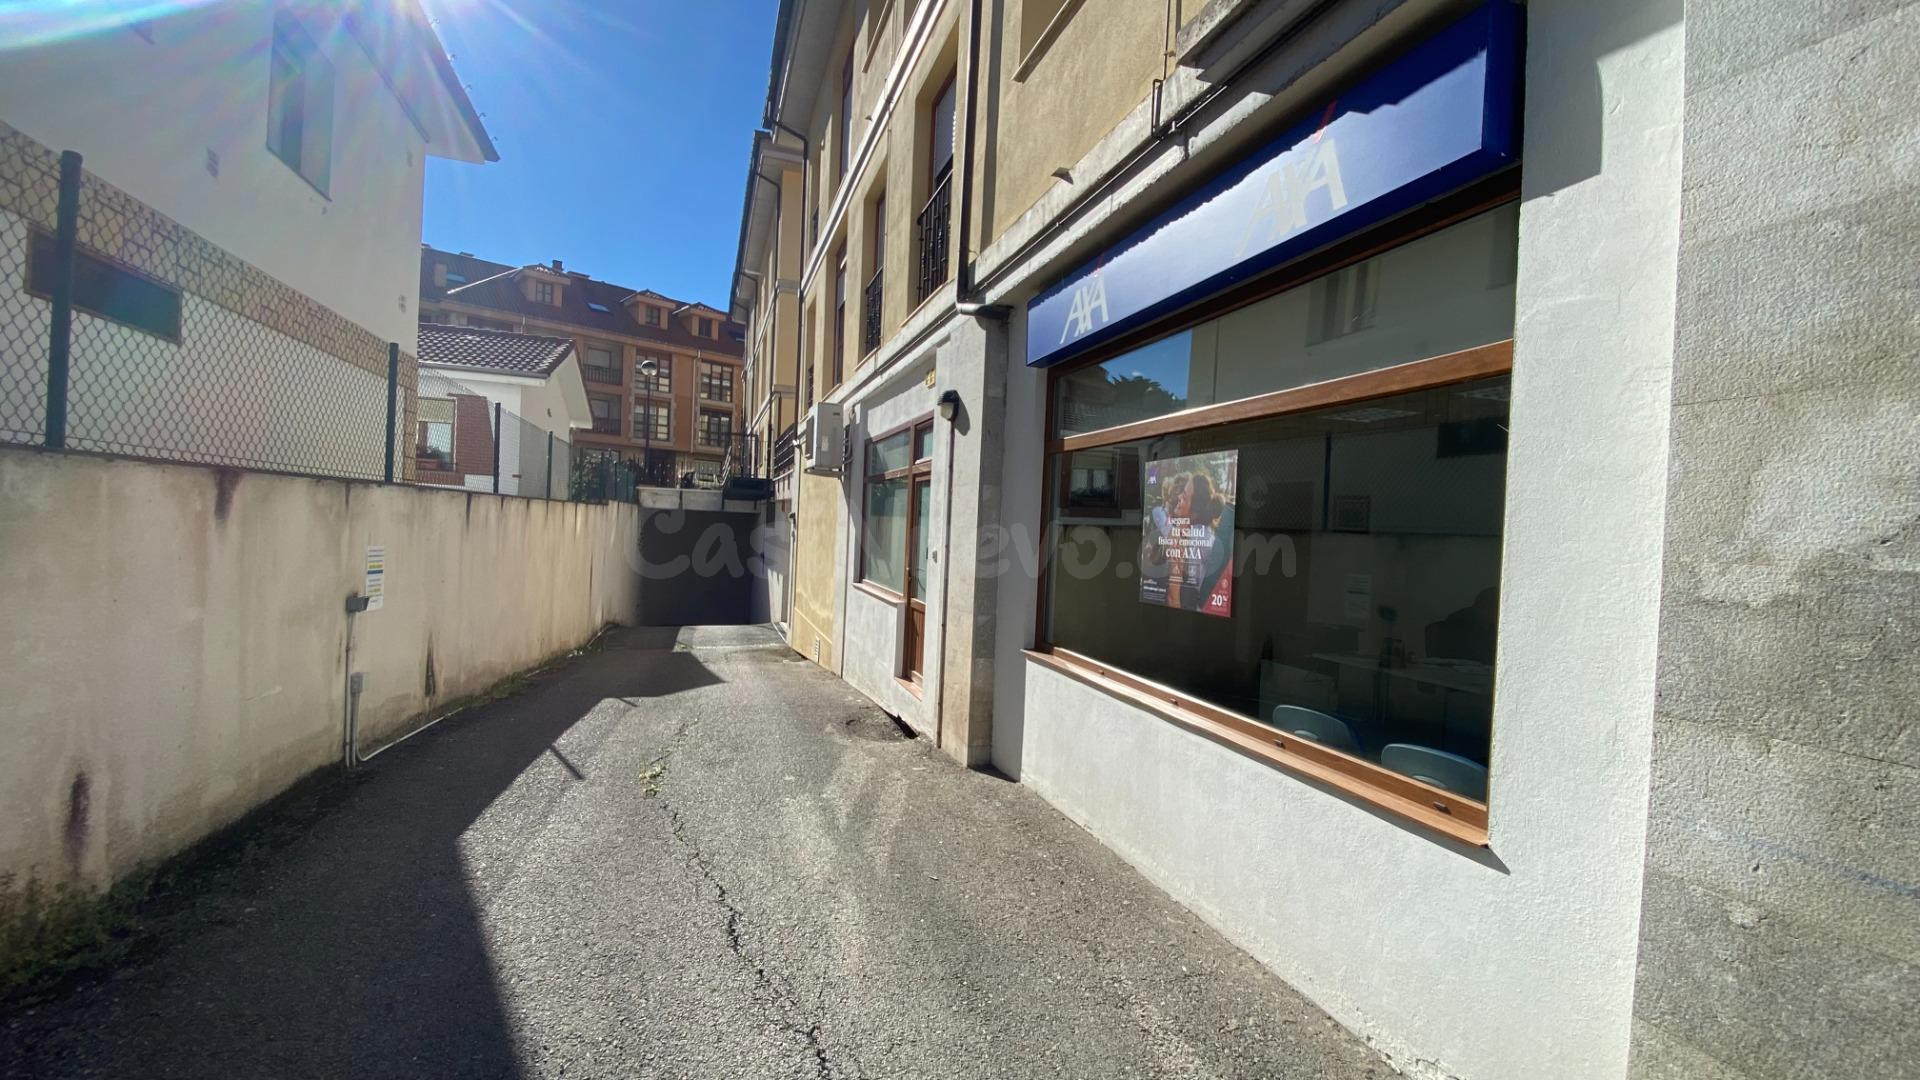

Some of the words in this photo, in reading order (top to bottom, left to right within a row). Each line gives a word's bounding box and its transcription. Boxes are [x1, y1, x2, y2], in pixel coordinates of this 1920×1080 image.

[1235, 139, 1347, 256] AXA
[1060, 278, 1108, 344] AXA
[1167, 516, 1190, 526] Asegura
[1171, 527, 1180, 536] tu
[1181, 525, 1205, 537] salud
[1174, 538, 1179, 547] y
[1179, 537, 1213, 547] emocional
[1165, 549, 1180, 558] con
[1182, 548, 1201, 559] AXA
